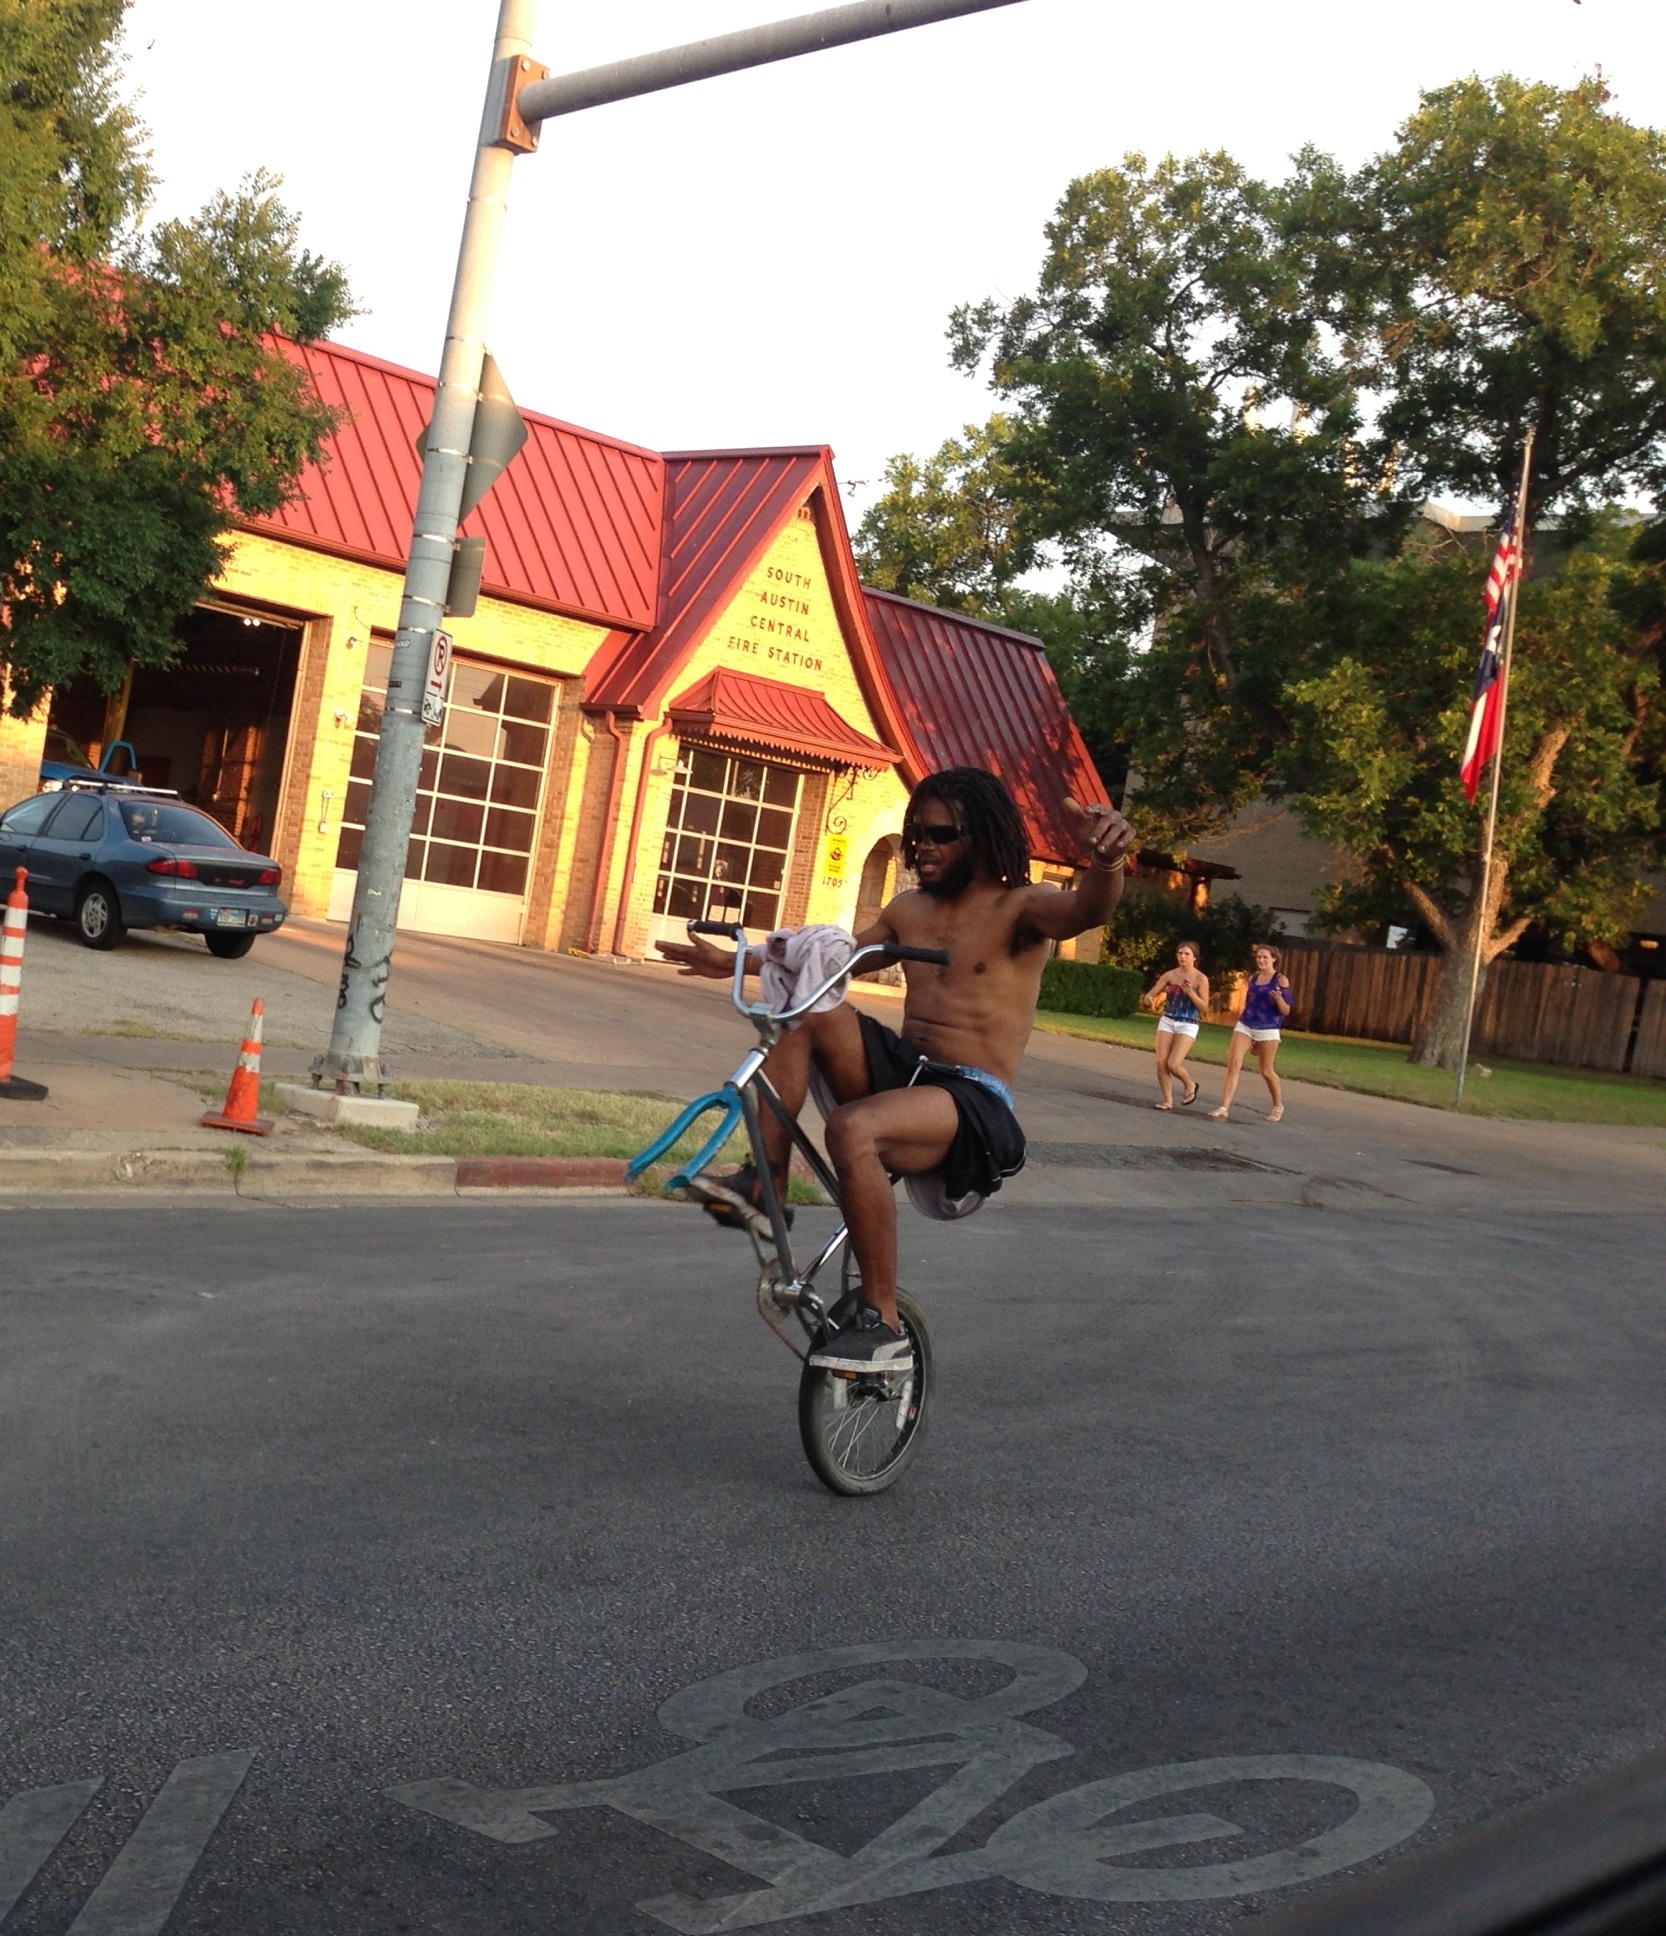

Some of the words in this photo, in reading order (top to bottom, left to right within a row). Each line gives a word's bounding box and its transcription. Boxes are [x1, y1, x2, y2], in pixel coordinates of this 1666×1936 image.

[767, 567, 811, 590] SOUTH
[760, 592, 810, 615] AUSTIN
[750, 615, 810, 642] CENTRAL
[768, 647, 822, 671] STATION
